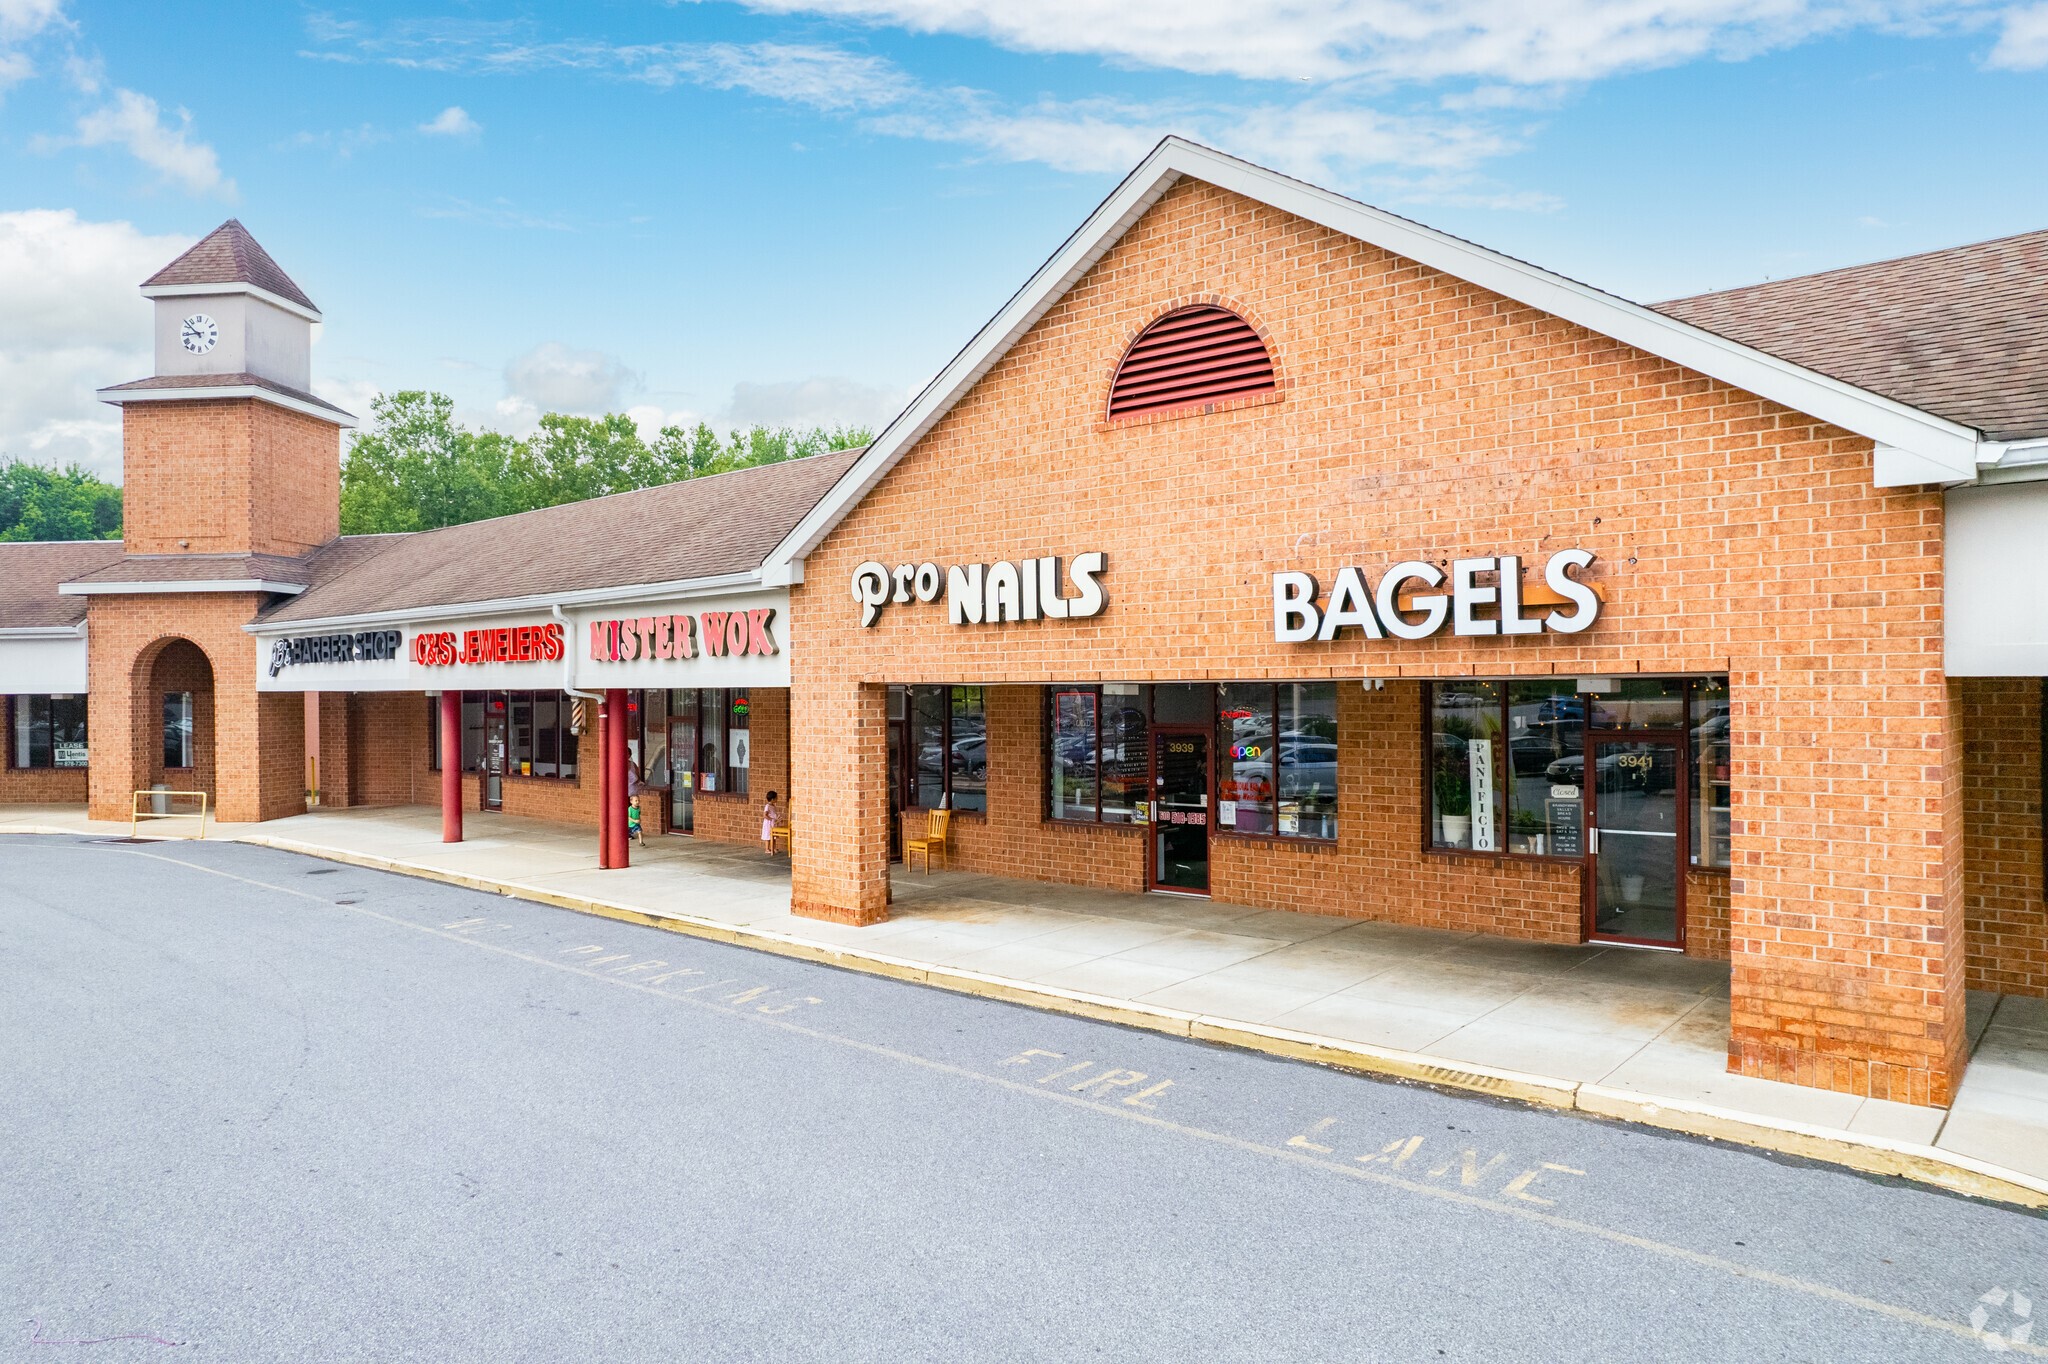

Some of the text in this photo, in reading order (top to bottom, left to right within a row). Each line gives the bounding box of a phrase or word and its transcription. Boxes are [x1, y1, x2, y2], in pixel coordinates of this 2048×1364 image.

[948, 552, 1109, 625] NAILS
[1273, 548, 1599, 643] BAGELS
[293, 634, 353, 664] BARBER
[353, 630, 402, 661] SHOP
[416, 623, 564, 666] C&S JEWELERS
[589, 608, 779, 662] MISTER WOK
[1170, 743, 1194, 753] 3939
[1619, 755, 1653, 768] 3941
[1476, 743, 1488, 849] PANIFICIO
[1286, 1116, 1587, 1206] LANE
